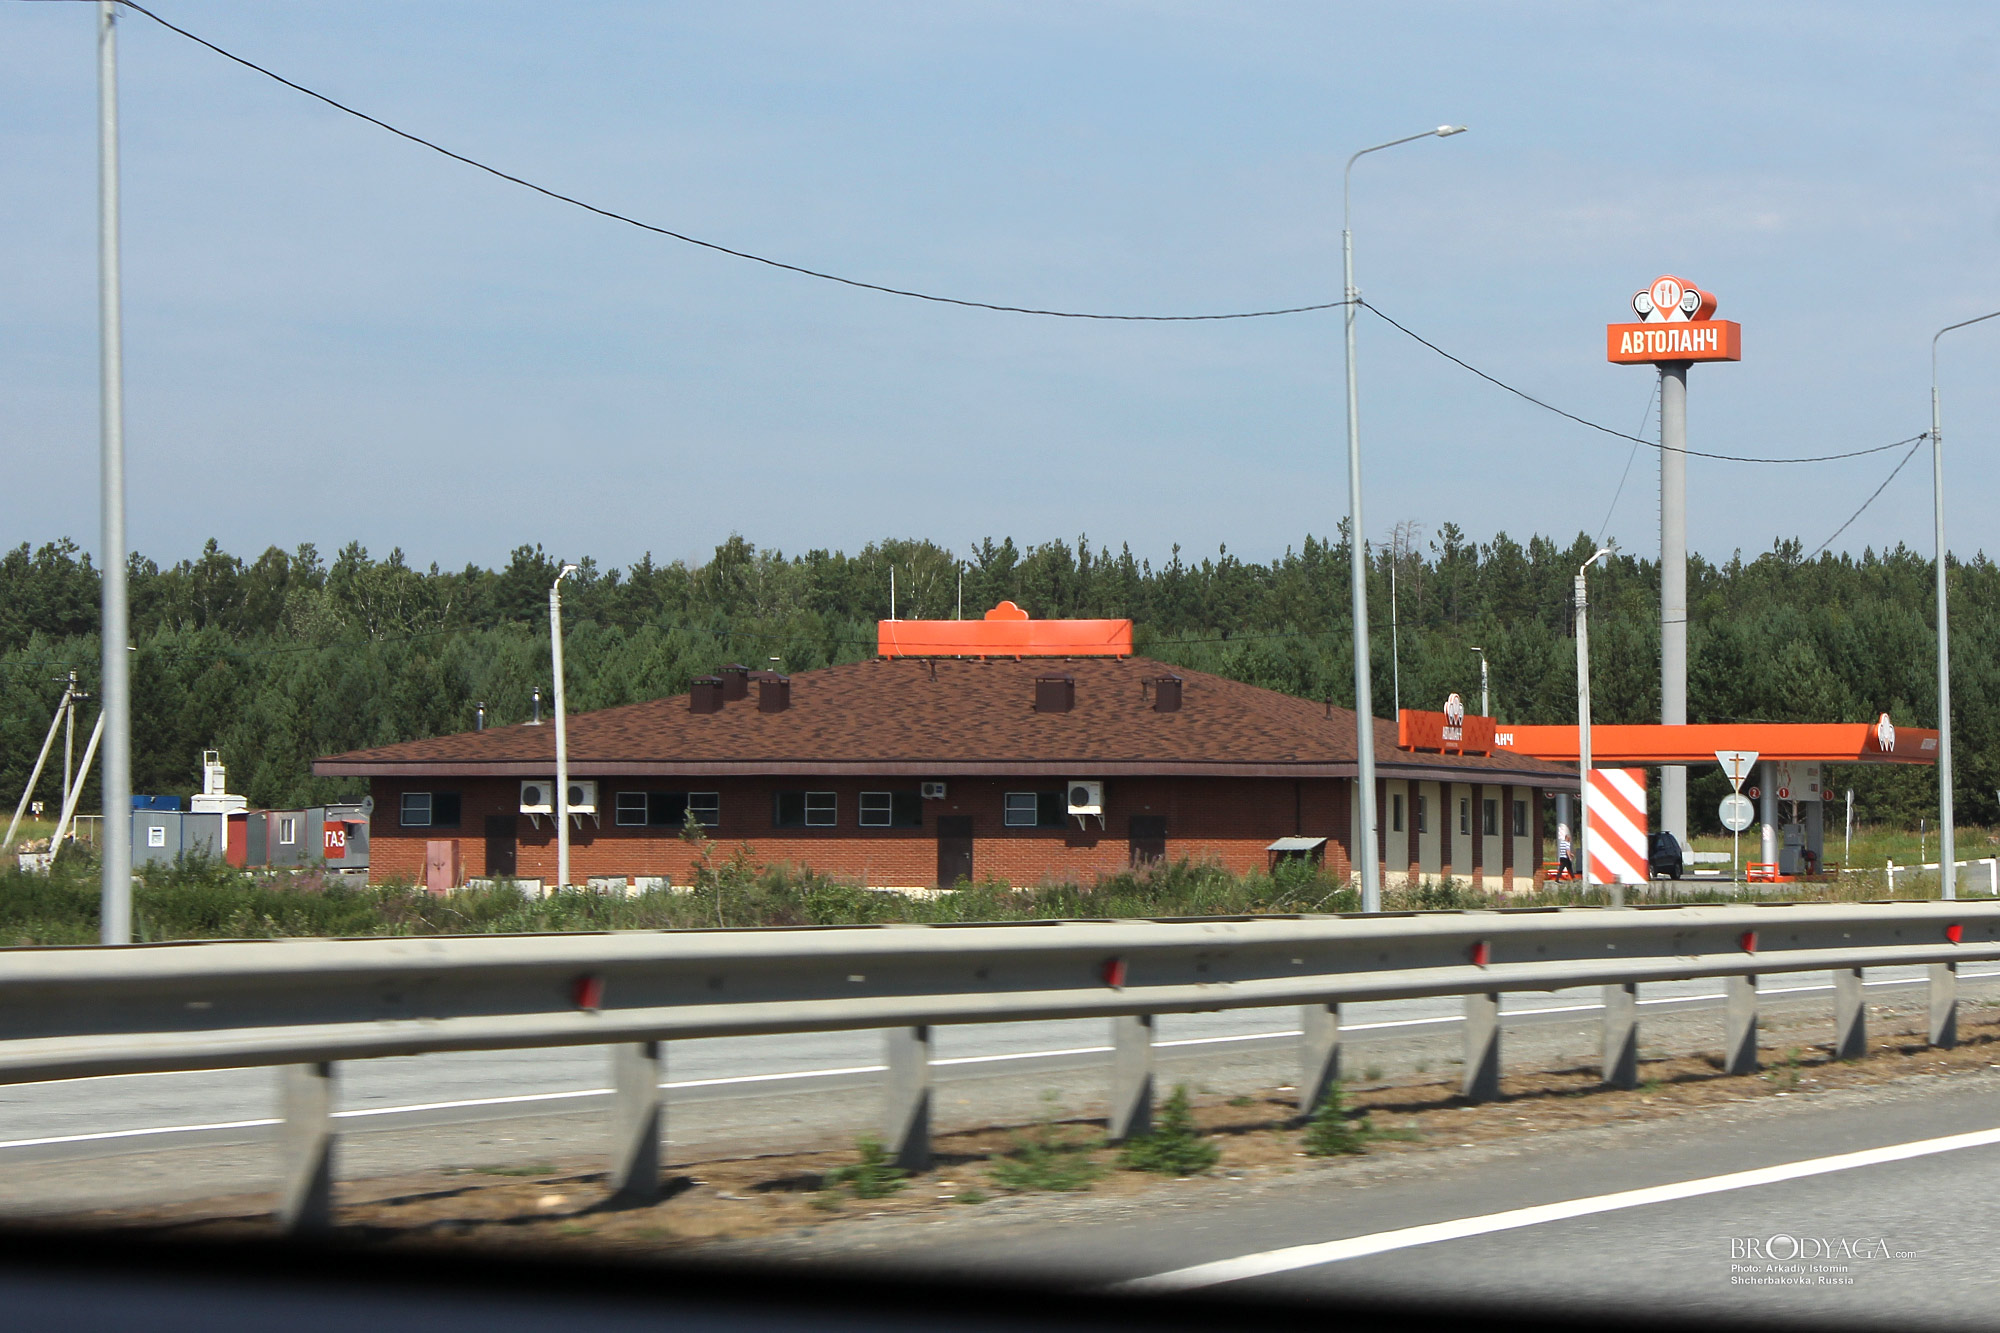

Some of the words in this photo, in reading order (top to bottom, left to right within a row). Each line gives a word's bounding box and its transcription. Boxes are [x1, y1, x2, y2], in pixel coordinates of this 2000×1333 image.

[1620, 328, 1718, 354] АВТОЛАНЧ
[1495, 732, 1514, 746] АНЧ
[325, 830, 345, 847] ГАЗ
